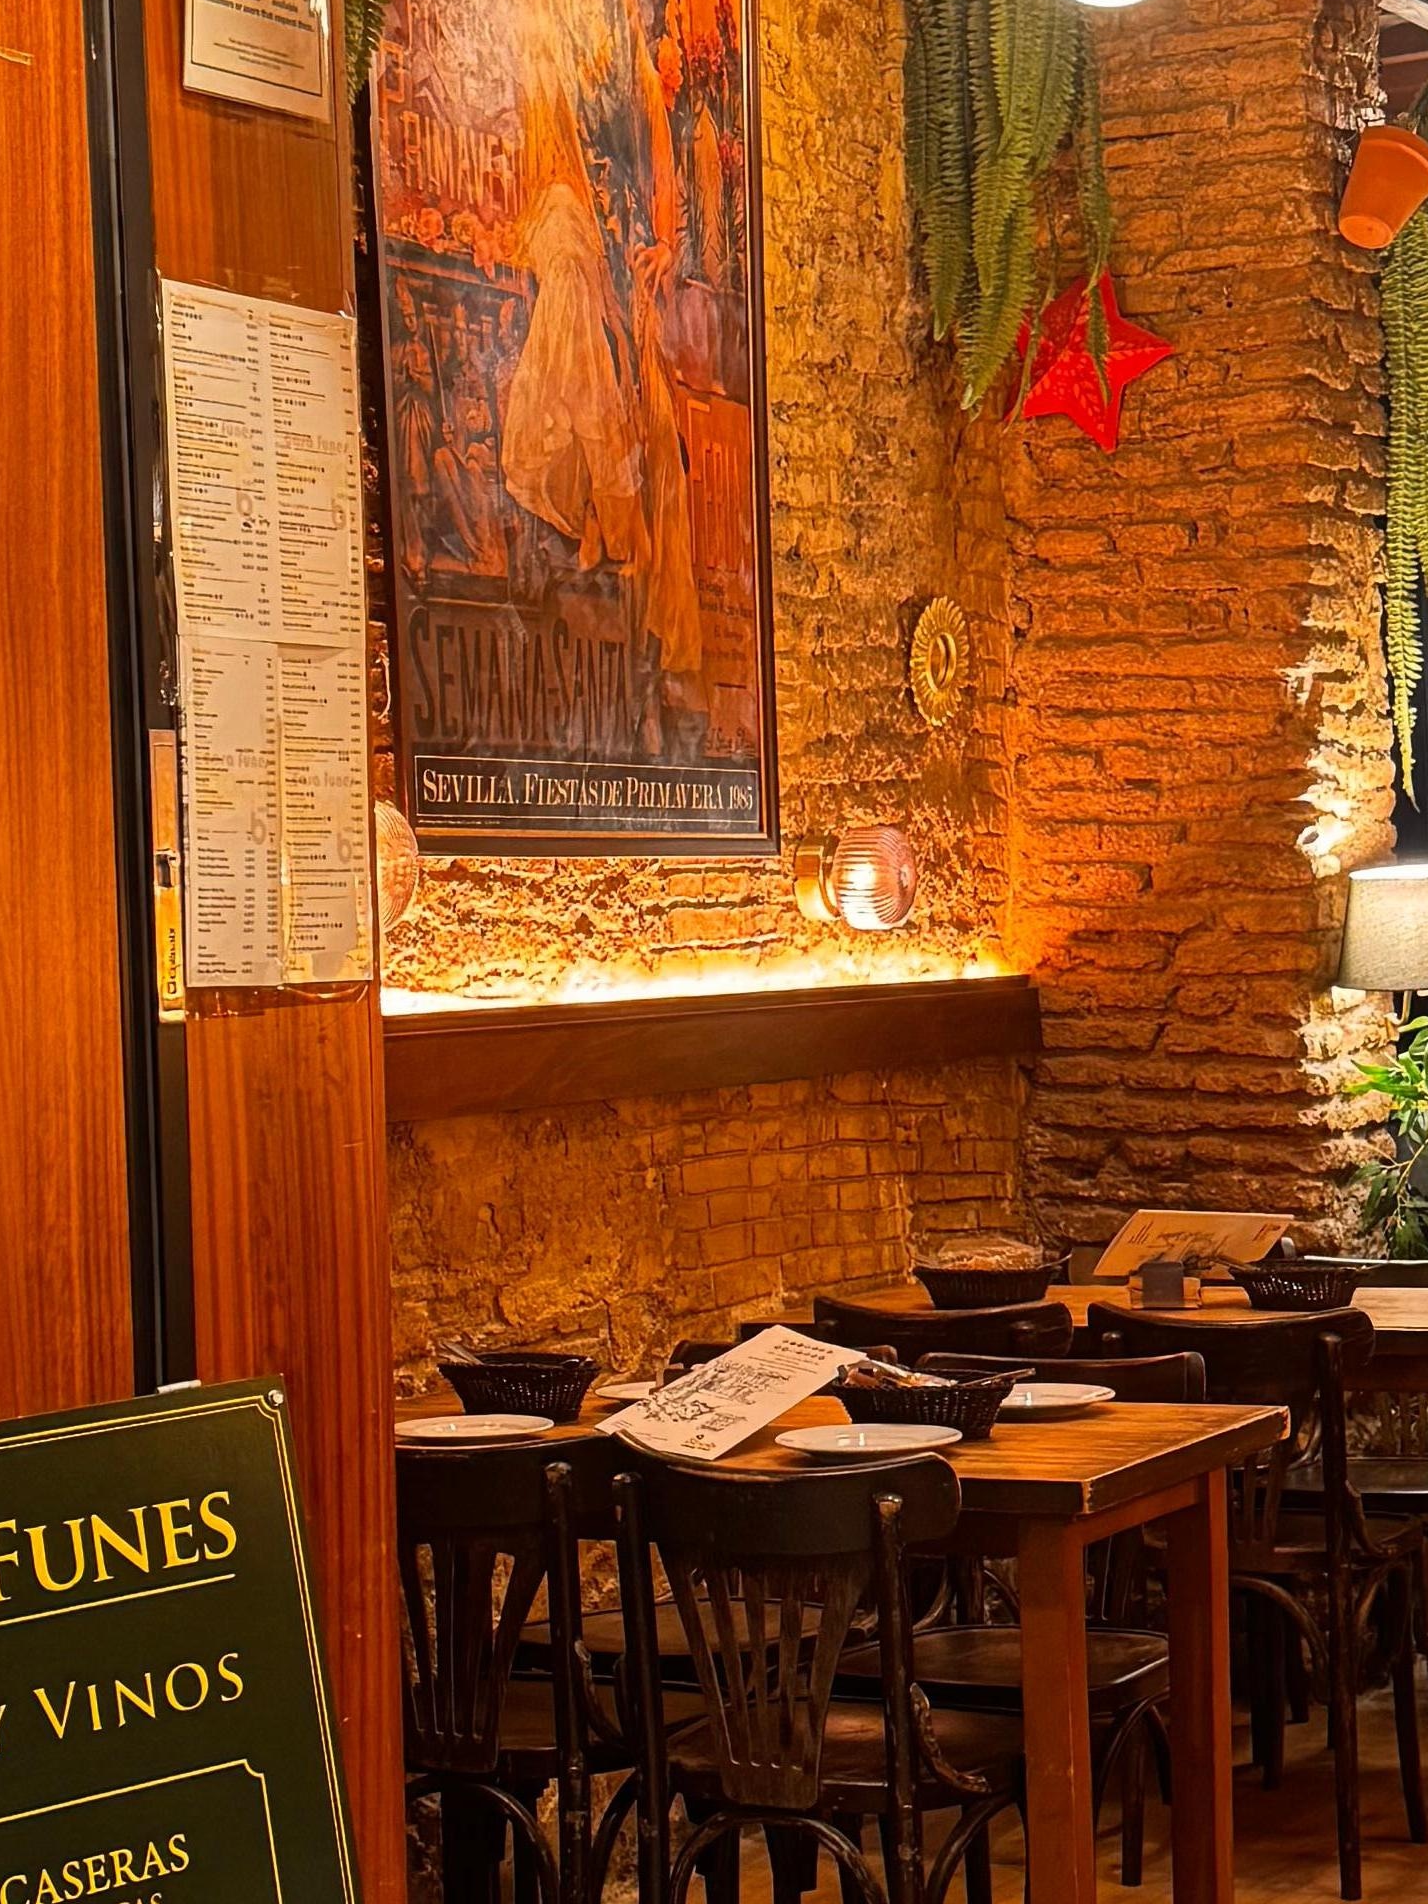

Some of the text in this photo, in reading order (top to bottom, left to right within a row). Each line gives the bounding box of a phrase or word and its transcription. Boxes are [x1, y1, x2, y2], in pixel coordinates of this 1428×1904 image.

[422, 767, 520, 805] SEVILLA.
[523, 772, 600, 807] FIESTAS
[601, 779, 622, 807] DE
[626, 776, 725, 811] PRIMAVERA
[34, 1653, 243, 1739] VINOS
